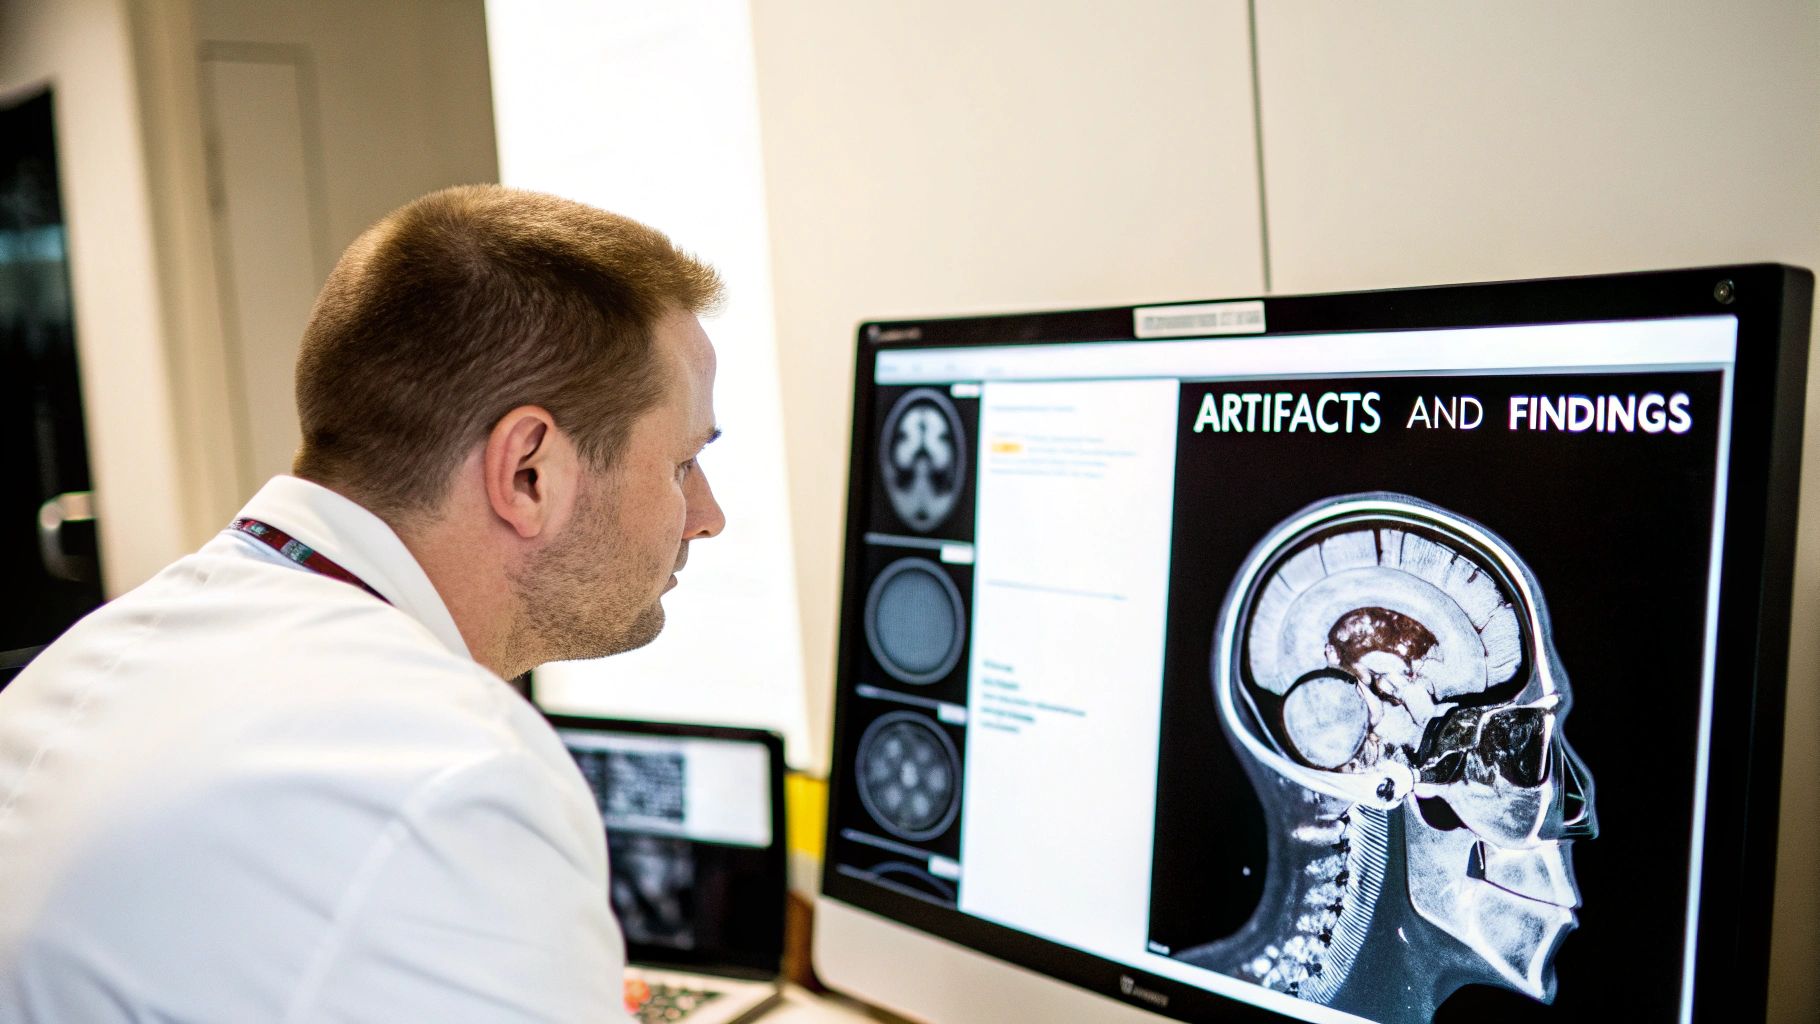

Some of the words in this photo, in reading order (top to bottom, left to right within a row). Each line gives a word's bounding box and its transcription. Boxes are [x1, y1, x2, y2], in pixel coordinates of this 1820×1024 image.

[1193, 391, 1382, 434] ARTIFACTS
[1406, 395, 1484, 430] AND
[1508, 392, 1693, 434] FINDINGS
